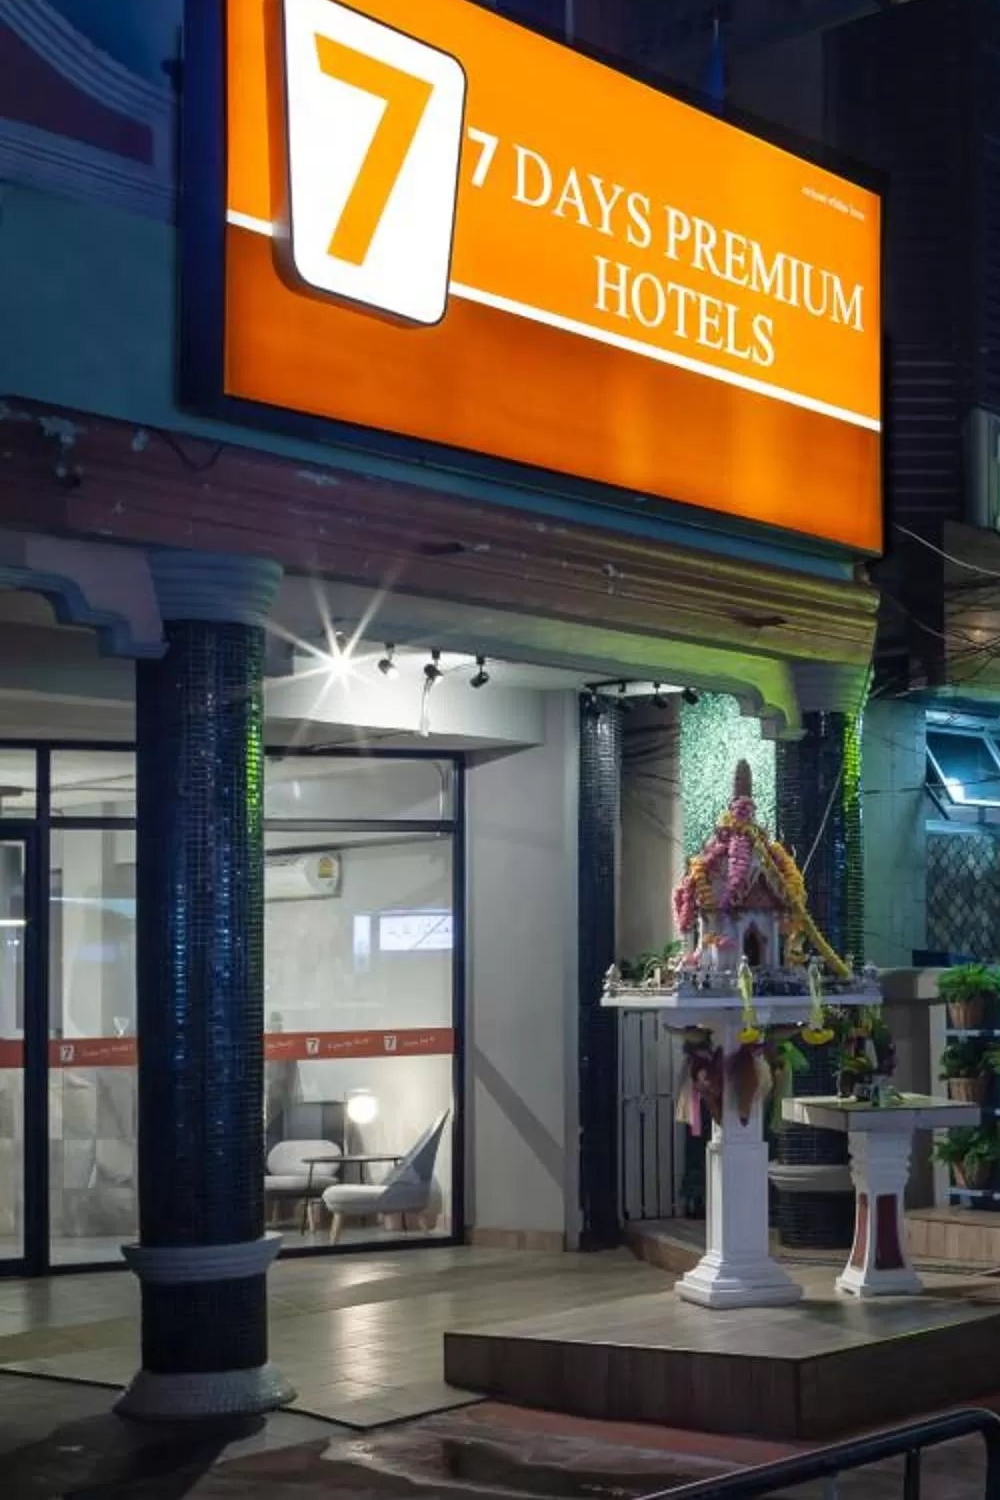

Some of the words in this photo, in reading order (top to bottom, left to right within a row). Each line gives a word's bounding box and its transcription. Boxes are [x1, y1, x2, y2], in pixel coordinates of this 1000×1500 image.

[313, 31, 435, 267] 7
[467, 127, 499, 186] 7
[512, 145, 652, 248] DAYS
[664, 205, 864, 332] PREMIUM
[595, 255, 775, 367] HOTELS
